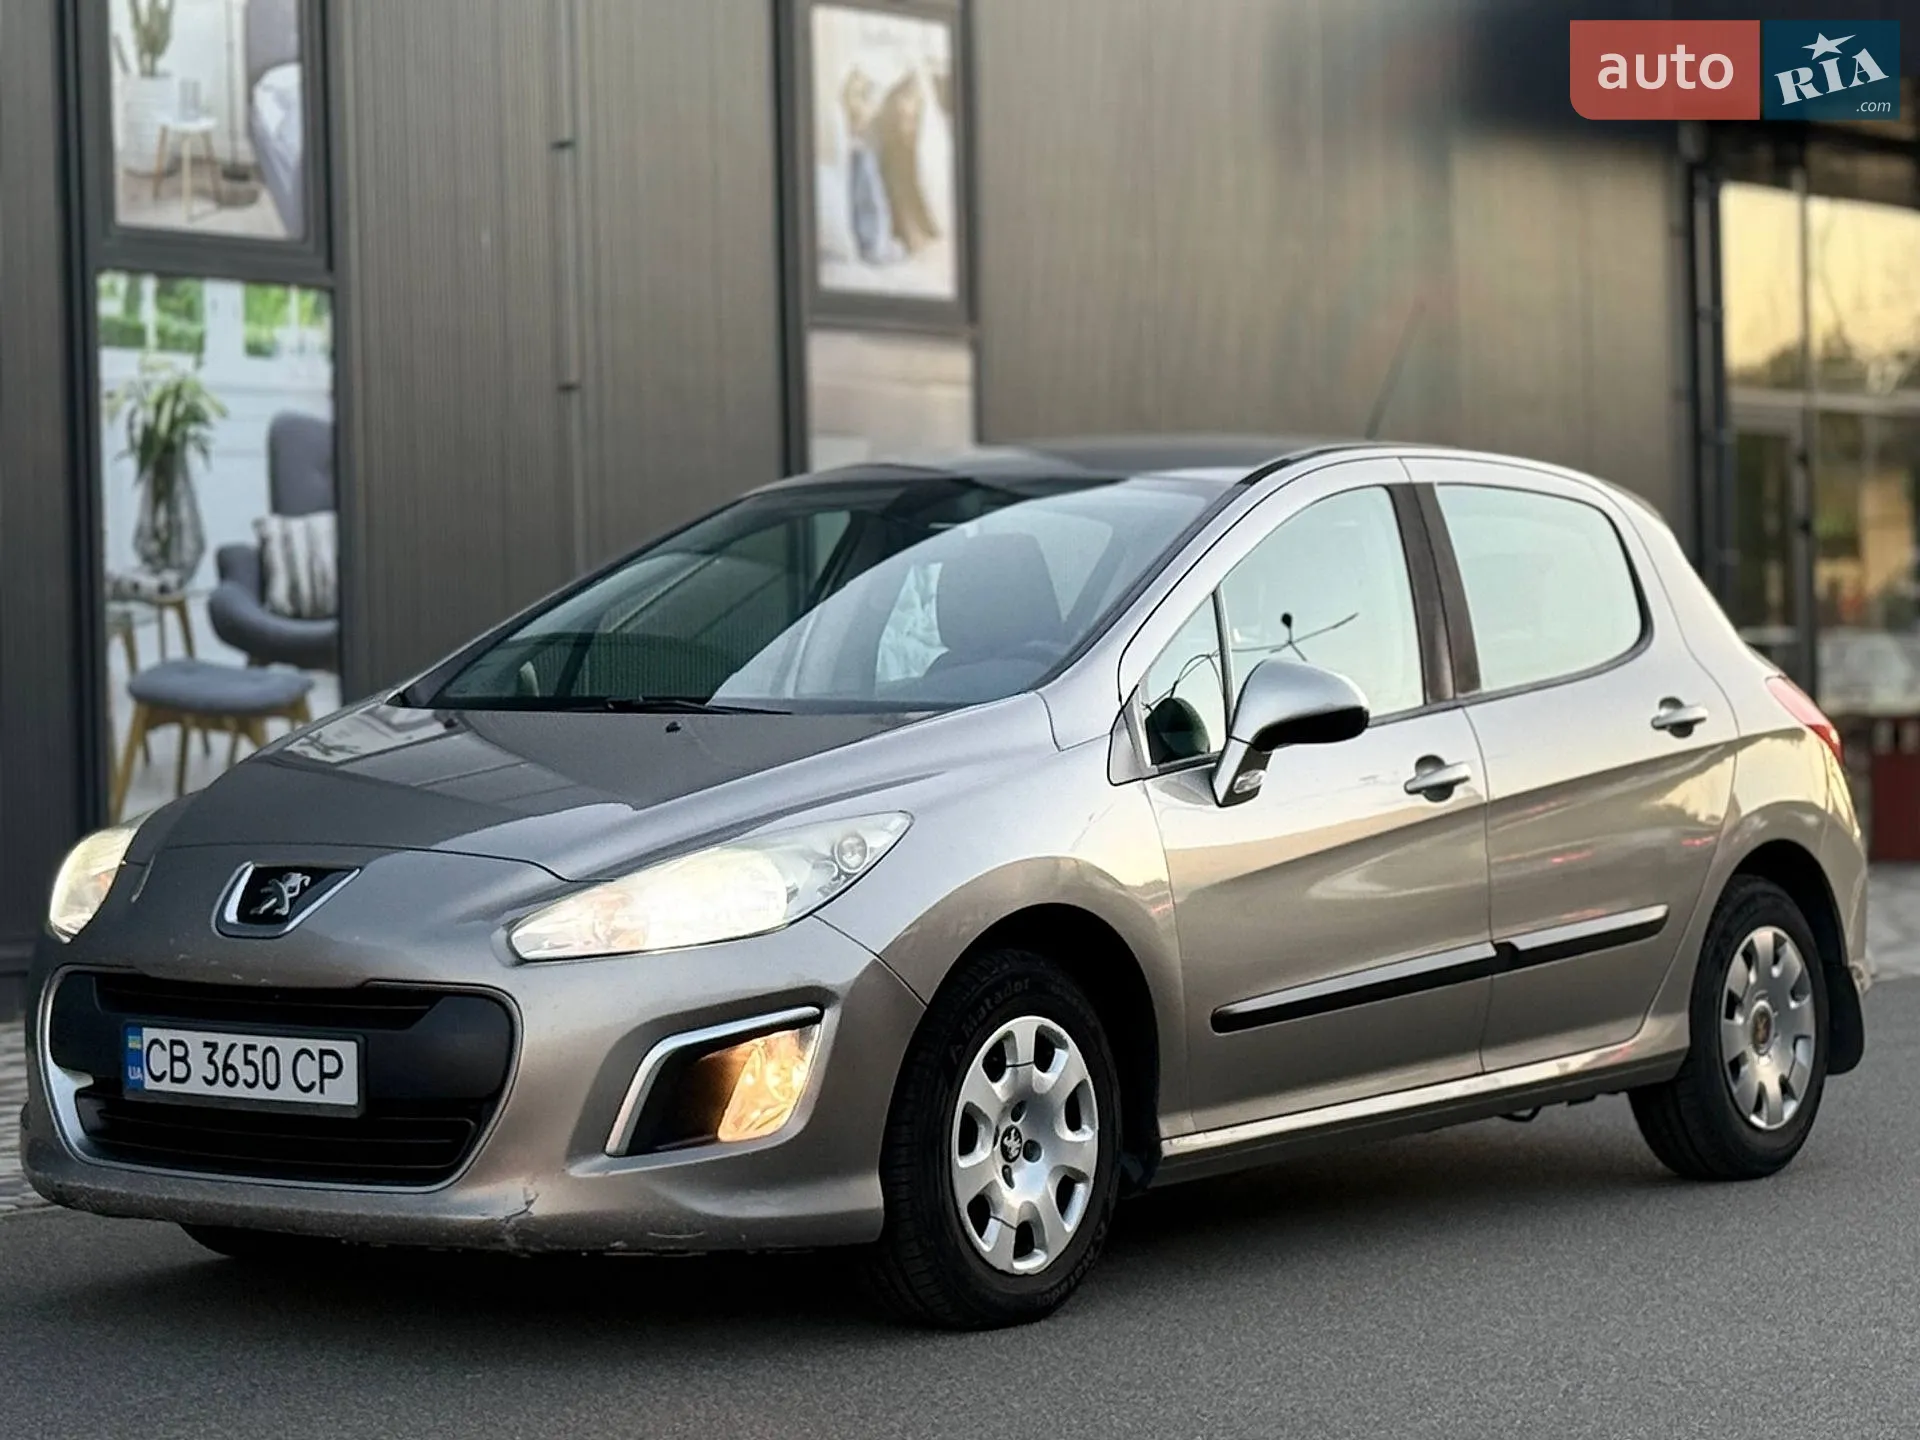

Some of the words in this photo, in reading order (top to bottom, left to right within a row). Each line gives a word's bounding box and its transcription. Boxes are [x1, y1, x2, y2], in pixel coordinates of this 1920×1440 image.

[127, 1066, 144, 1081] UA
[145, 1037, 192, 1084] CB
[202, 1041, 281, 1091] 3650
[292, 1047, 344, 1095] CP
